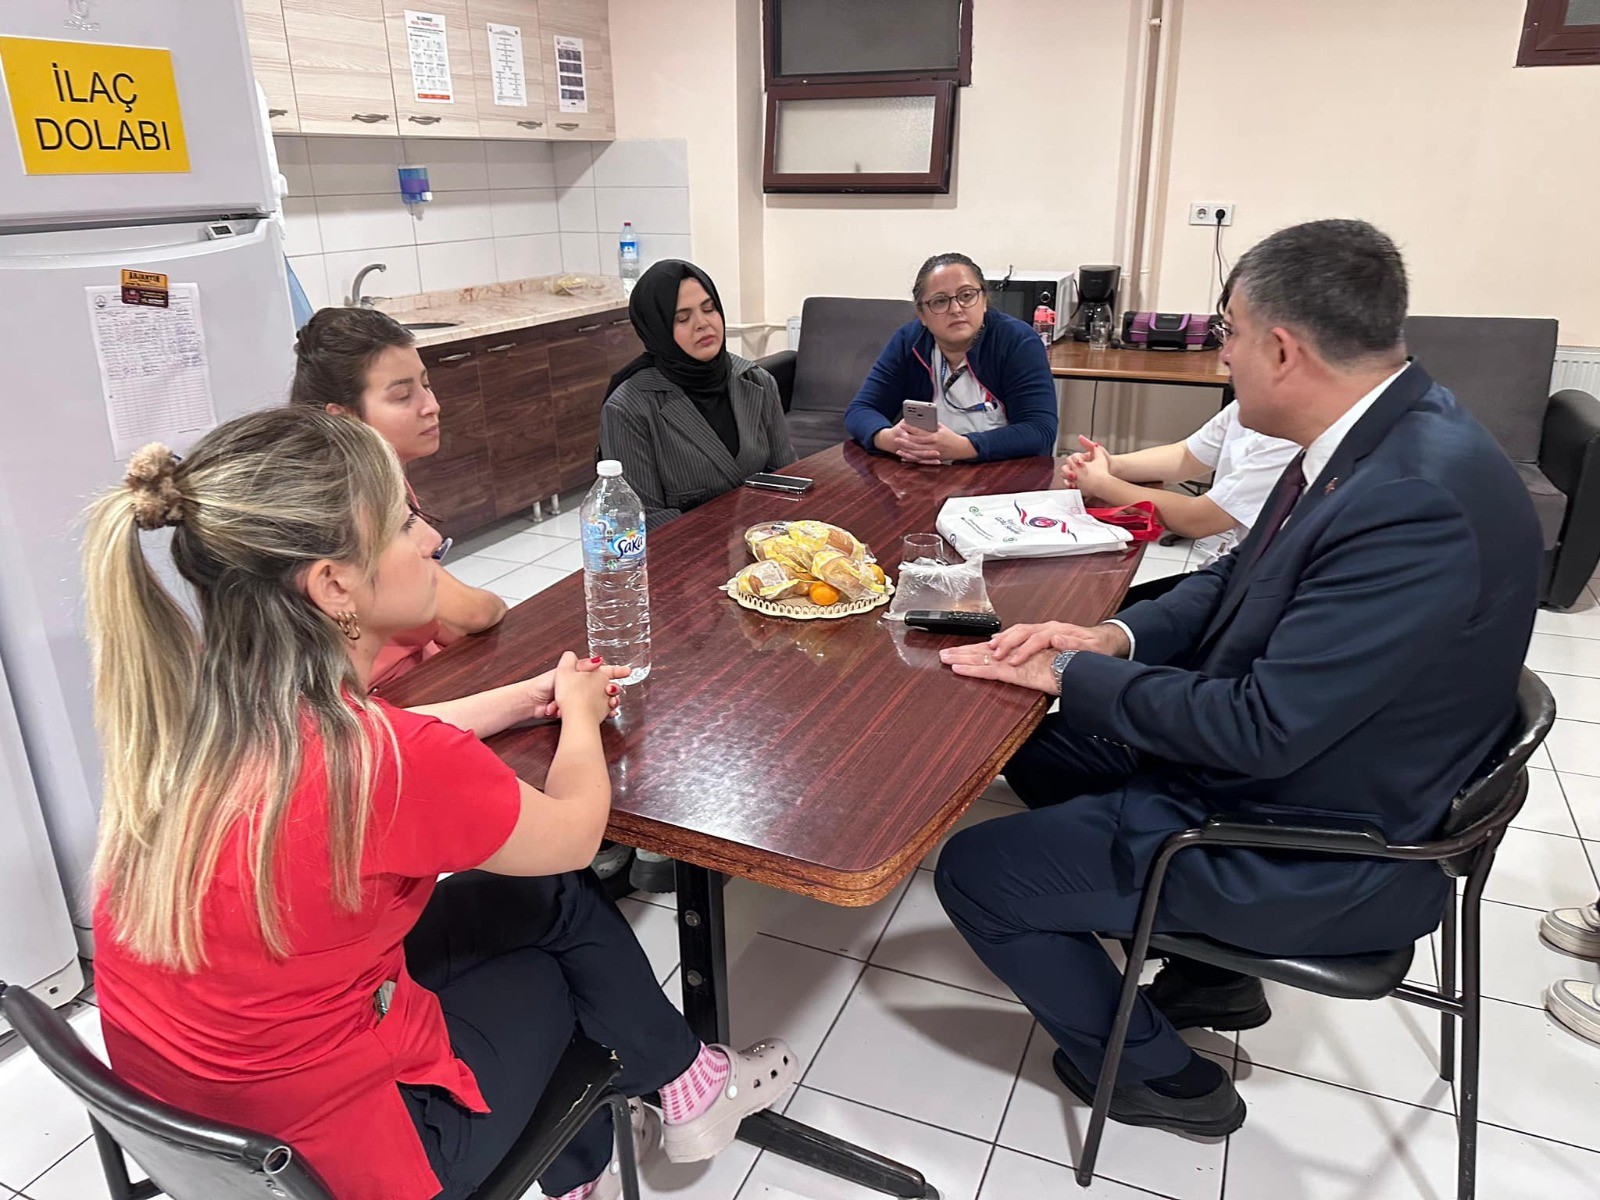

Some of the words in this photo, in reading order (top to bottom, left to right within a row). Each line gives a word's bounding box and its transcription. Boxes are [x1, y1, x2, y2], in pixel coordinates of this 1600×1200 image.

[52, 62, 137, 113] İLAÇ
[34, 118, 171, 151] DOLABI
[616, 536, 643, 560] Saka
